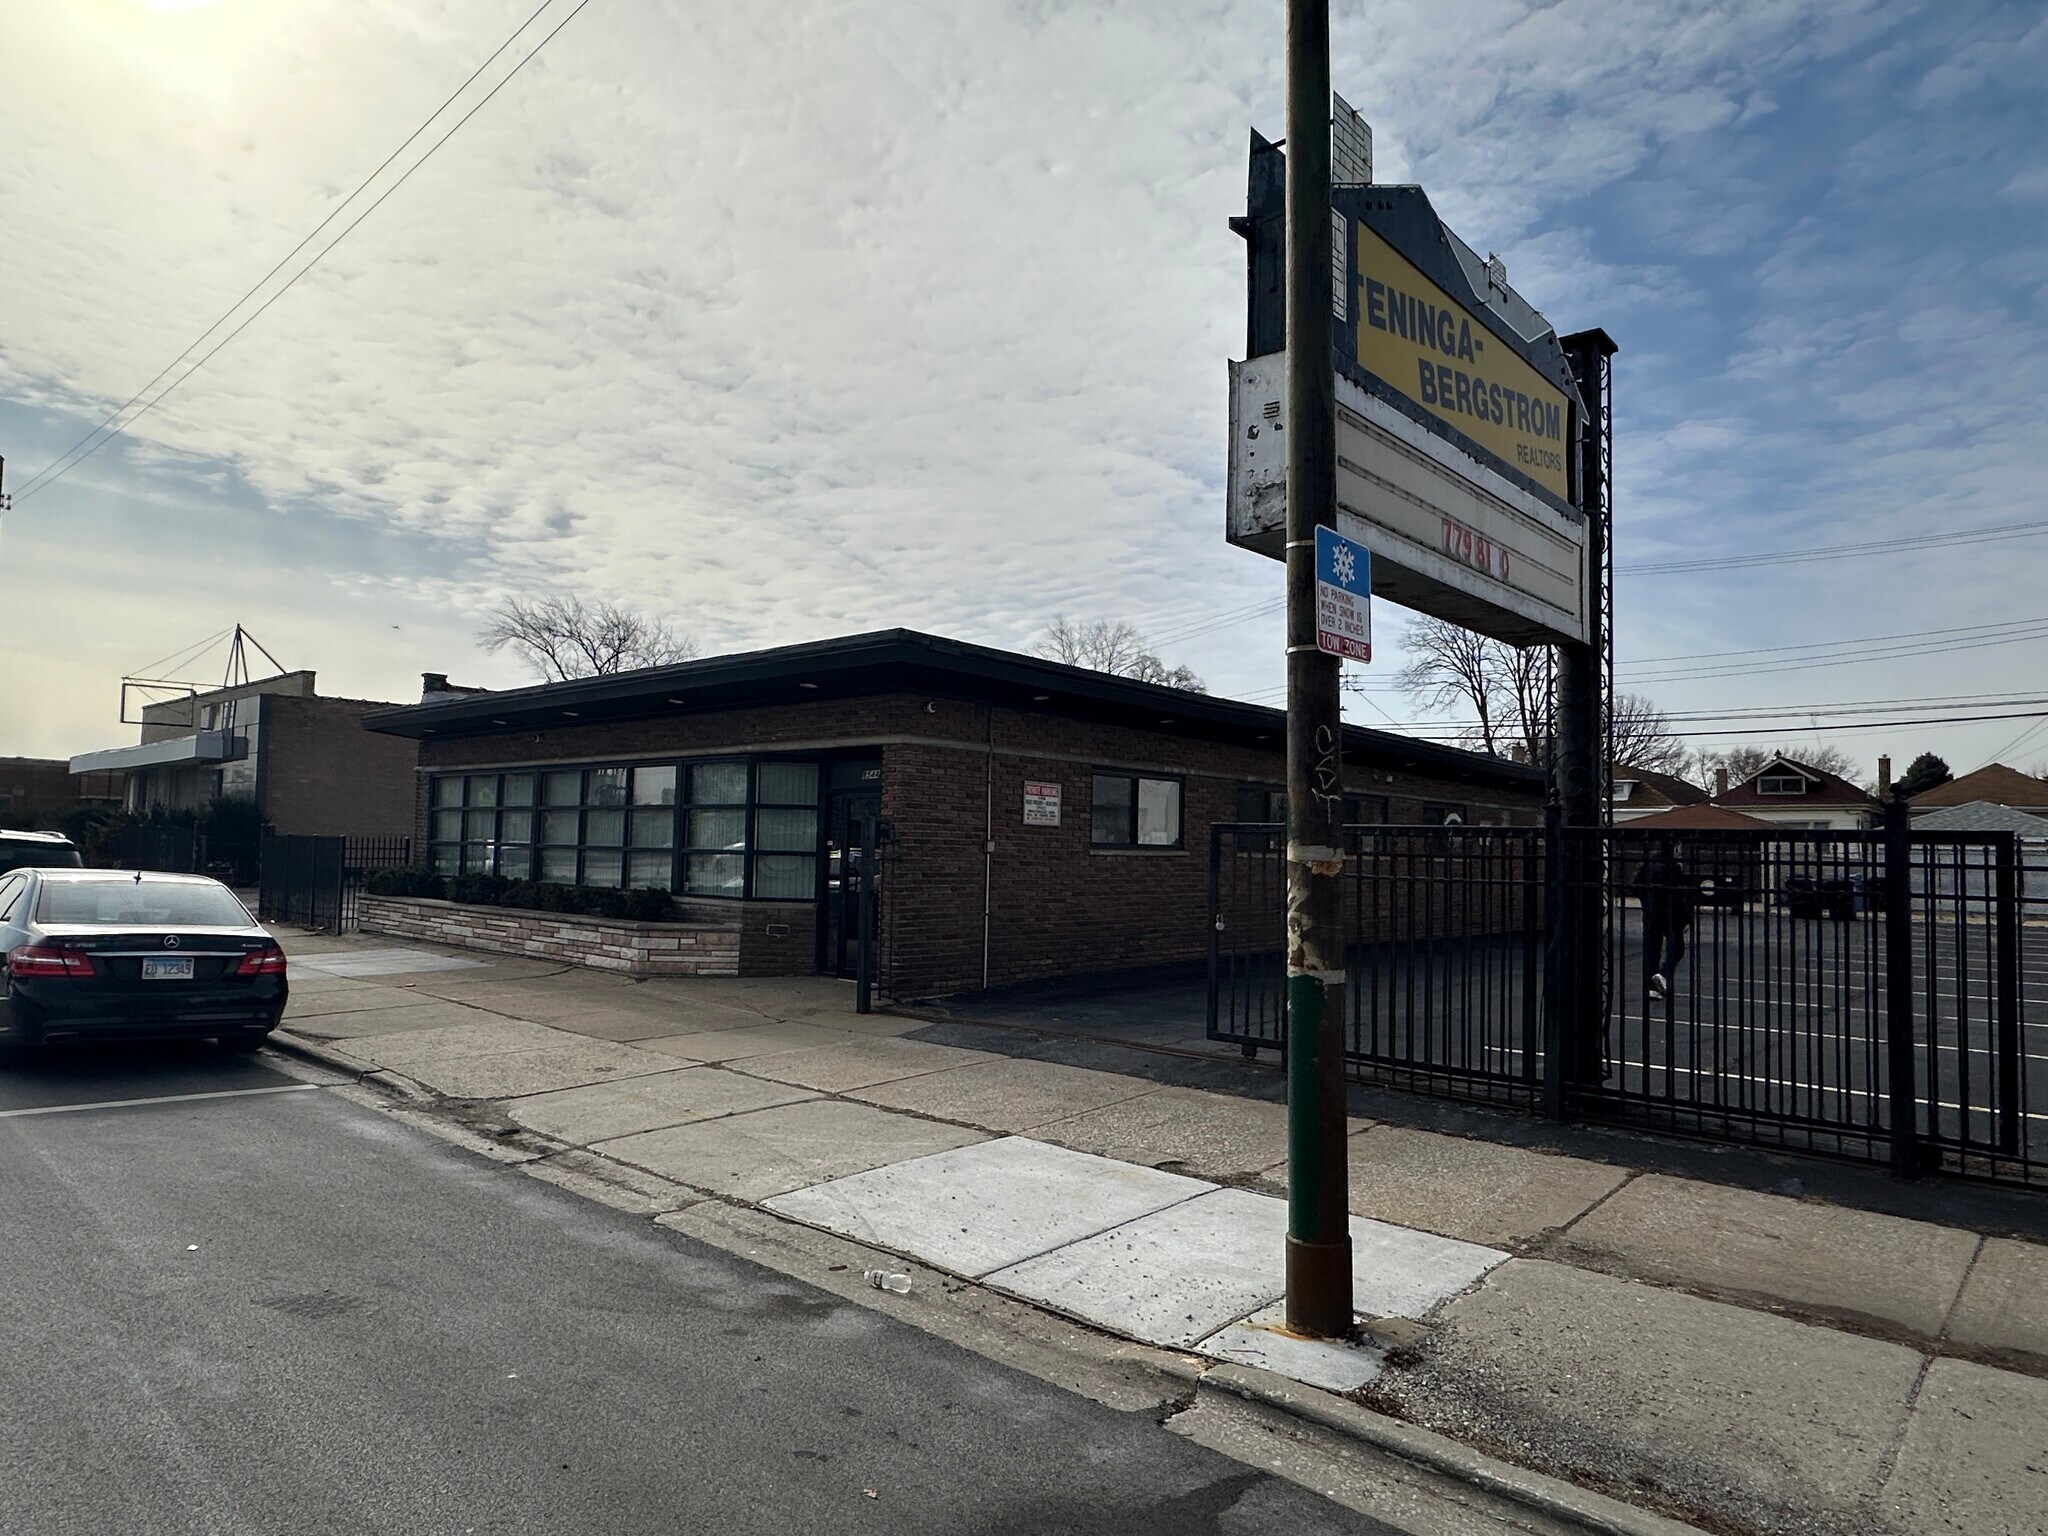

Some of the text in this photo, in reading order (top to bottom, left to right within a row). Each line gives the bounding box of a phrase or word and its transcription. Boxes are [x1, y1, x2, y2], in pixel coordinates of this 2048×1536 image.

[1418, 357, 1561, 441] BERGSTROM
[1516, 443, 1562, 472] REALTORS
[1320, 585, 1355, 607] NO PARKING
[1320, 600, 1363, 623] WHEN SNOW IS
[1320, 613, 1365, 637] OVER 2 INCHES
[1320, 632, 1368, 659] TOW ZONE
